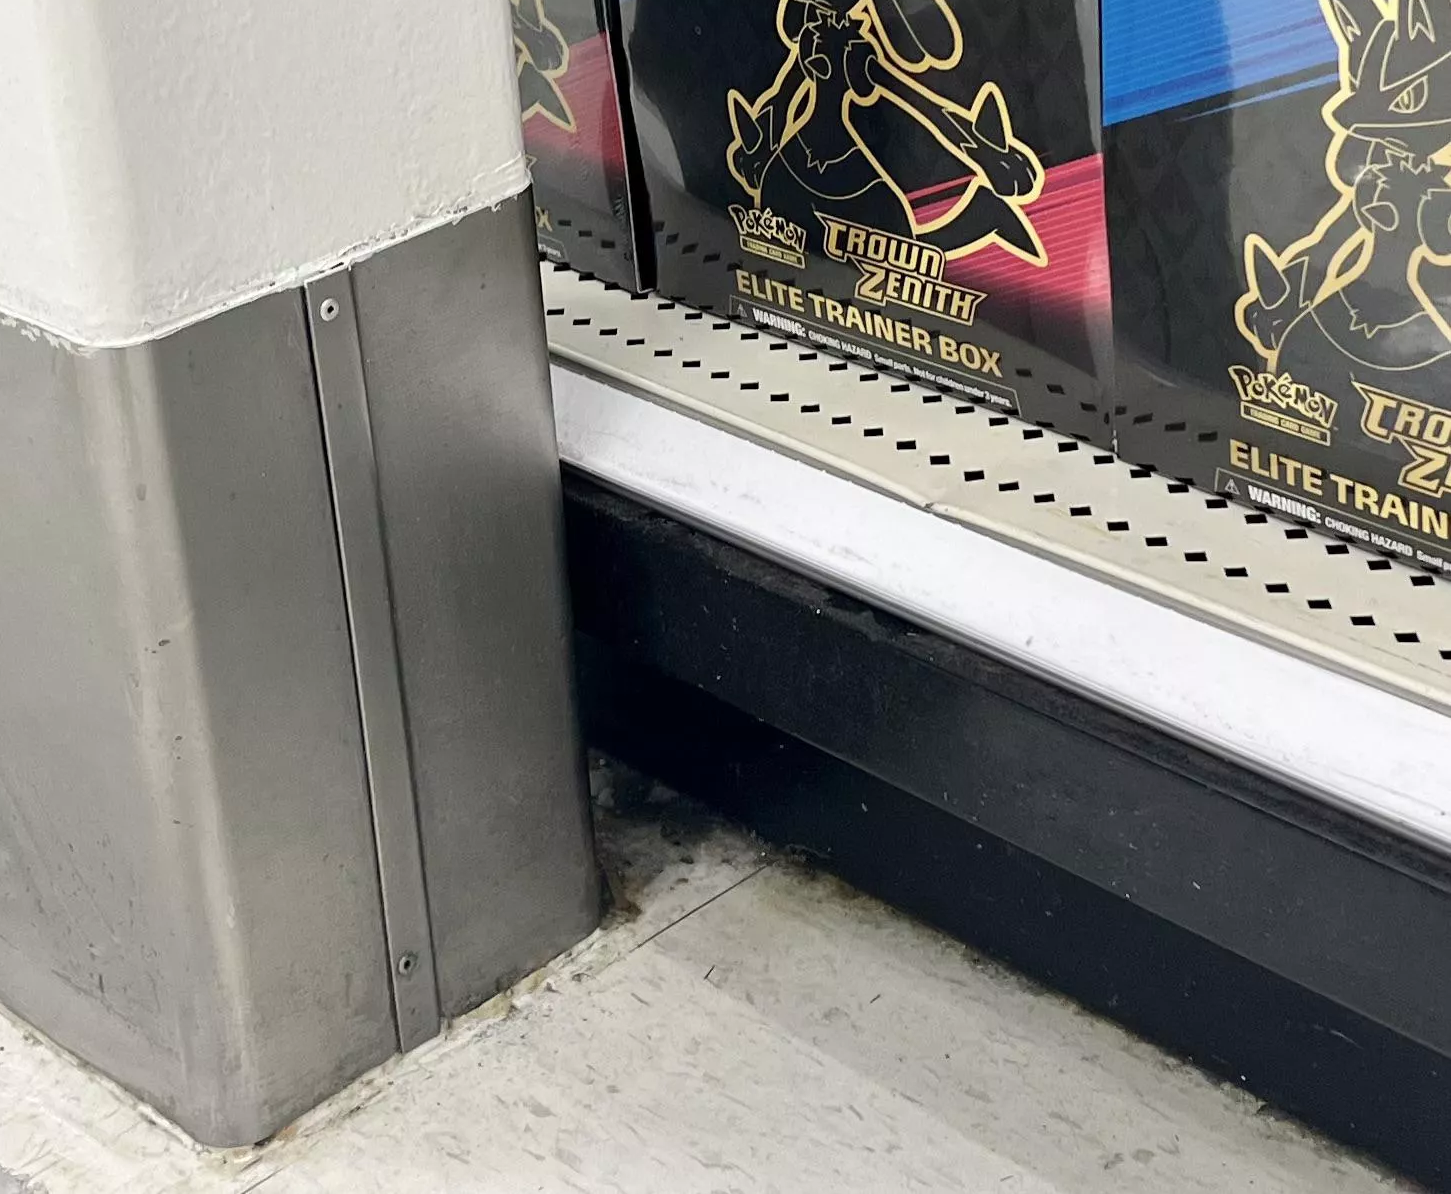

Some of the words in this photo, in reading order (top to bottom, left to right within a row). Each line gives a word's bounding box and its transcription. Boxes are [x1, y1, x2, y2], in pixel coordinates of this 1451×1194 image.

[825, 218, 942, 278] CROWN
[735, 268, 806, 313] ELITE
[808, 292, 934, 356] TRAINER
[939, 334, 1004, 379] BOX
[752, 307, 807, 338] WARNING:
[858, 265, 977, 321] ZENITH
[1229, 438, 1323, 496] ELITE
[1329, 473, 1449, 540] TRAIN
[1248, 484, 1322, 524] WARNING:
[1324, 516, 1370, 542] CHOKING
[1370, 532, 1414, 557] HAZARD
